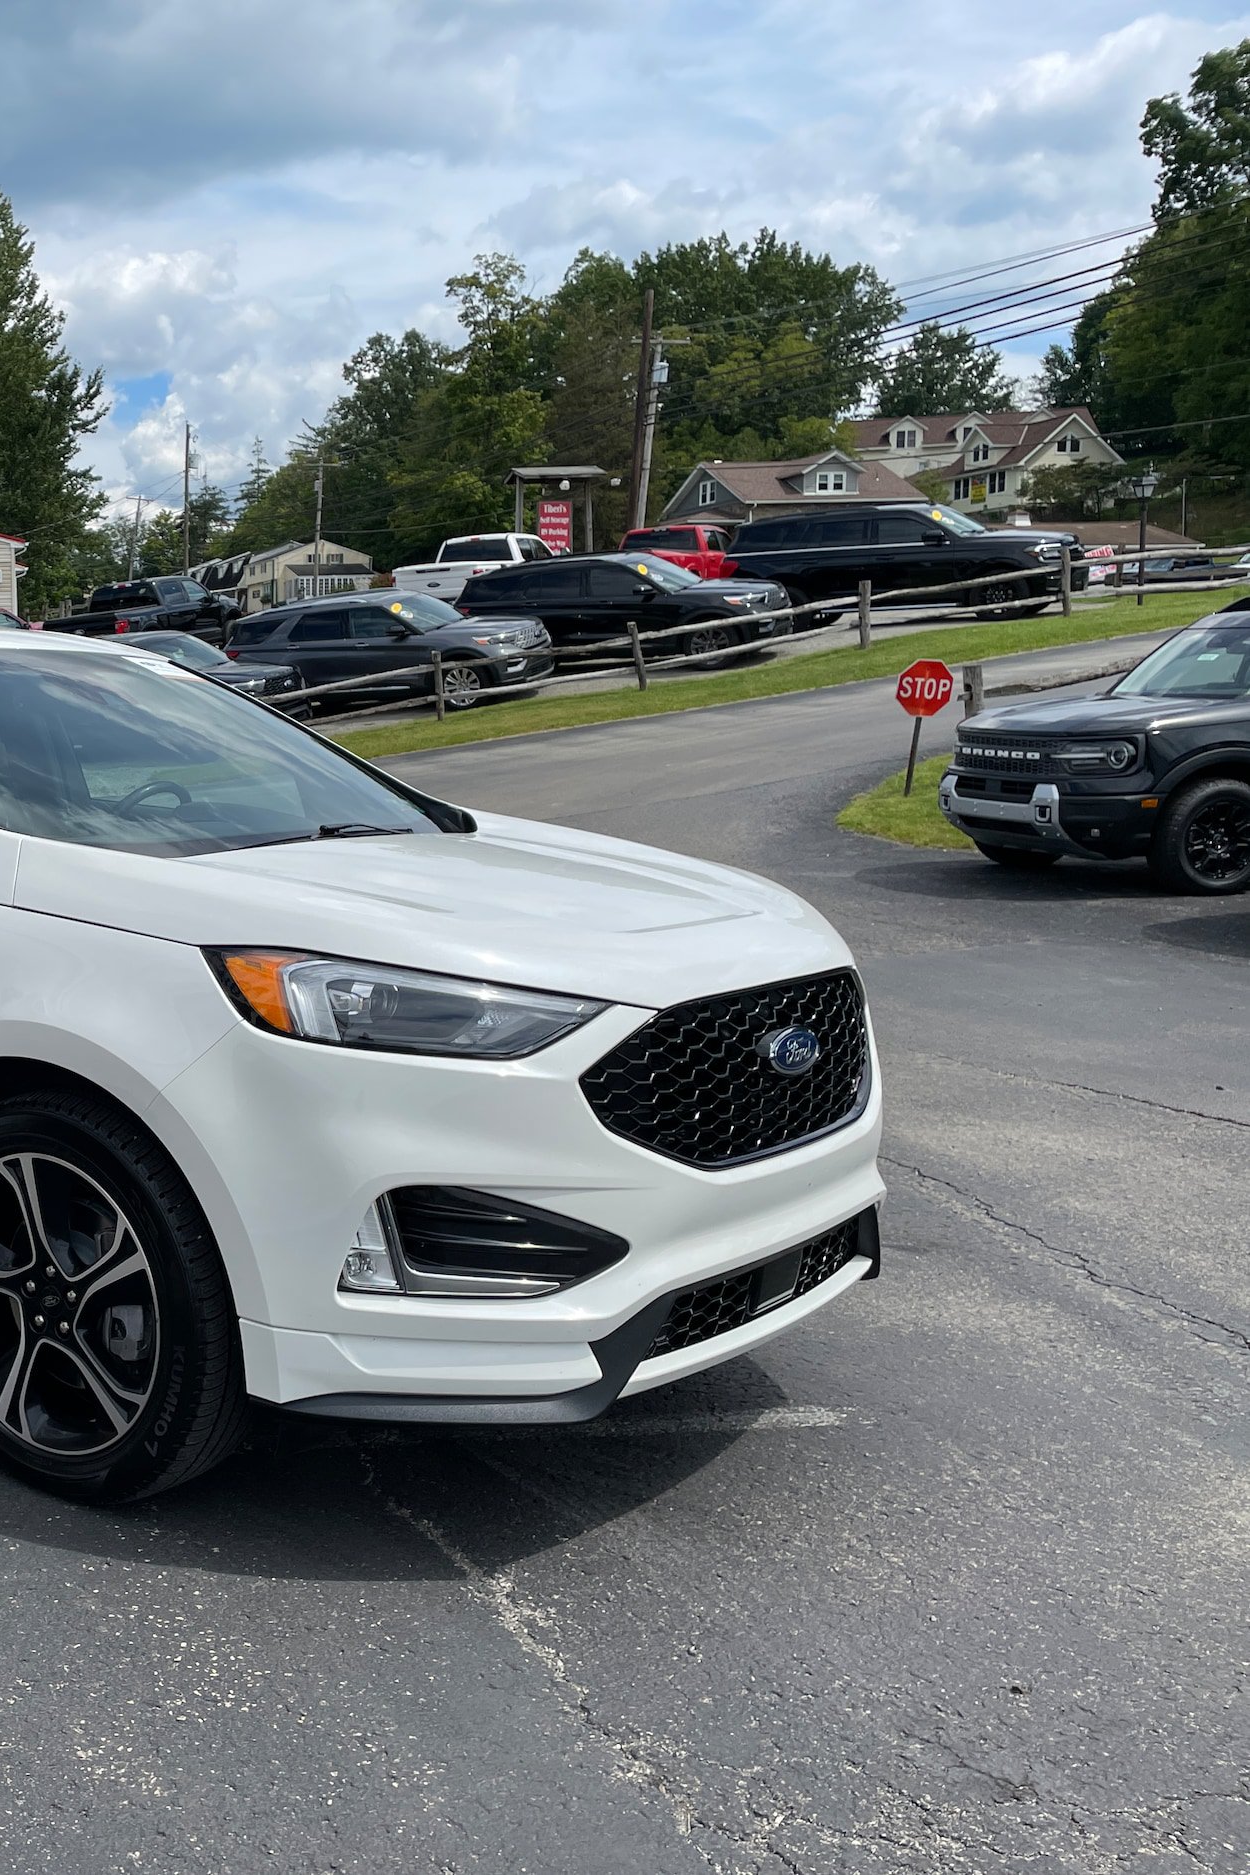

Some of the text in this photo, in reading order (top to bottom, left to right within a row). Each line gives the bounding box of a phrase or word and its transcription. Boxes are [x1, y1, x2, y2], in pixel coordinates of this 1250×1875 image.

[549, 527, 568, 536] Parking
[899, 676, 951, 700] STOP
[962, 747, 1041, 760] BRONCO
[786, 1037, 812, 1065] Ford
[153, 1344, 187, 1437] KUMHO
